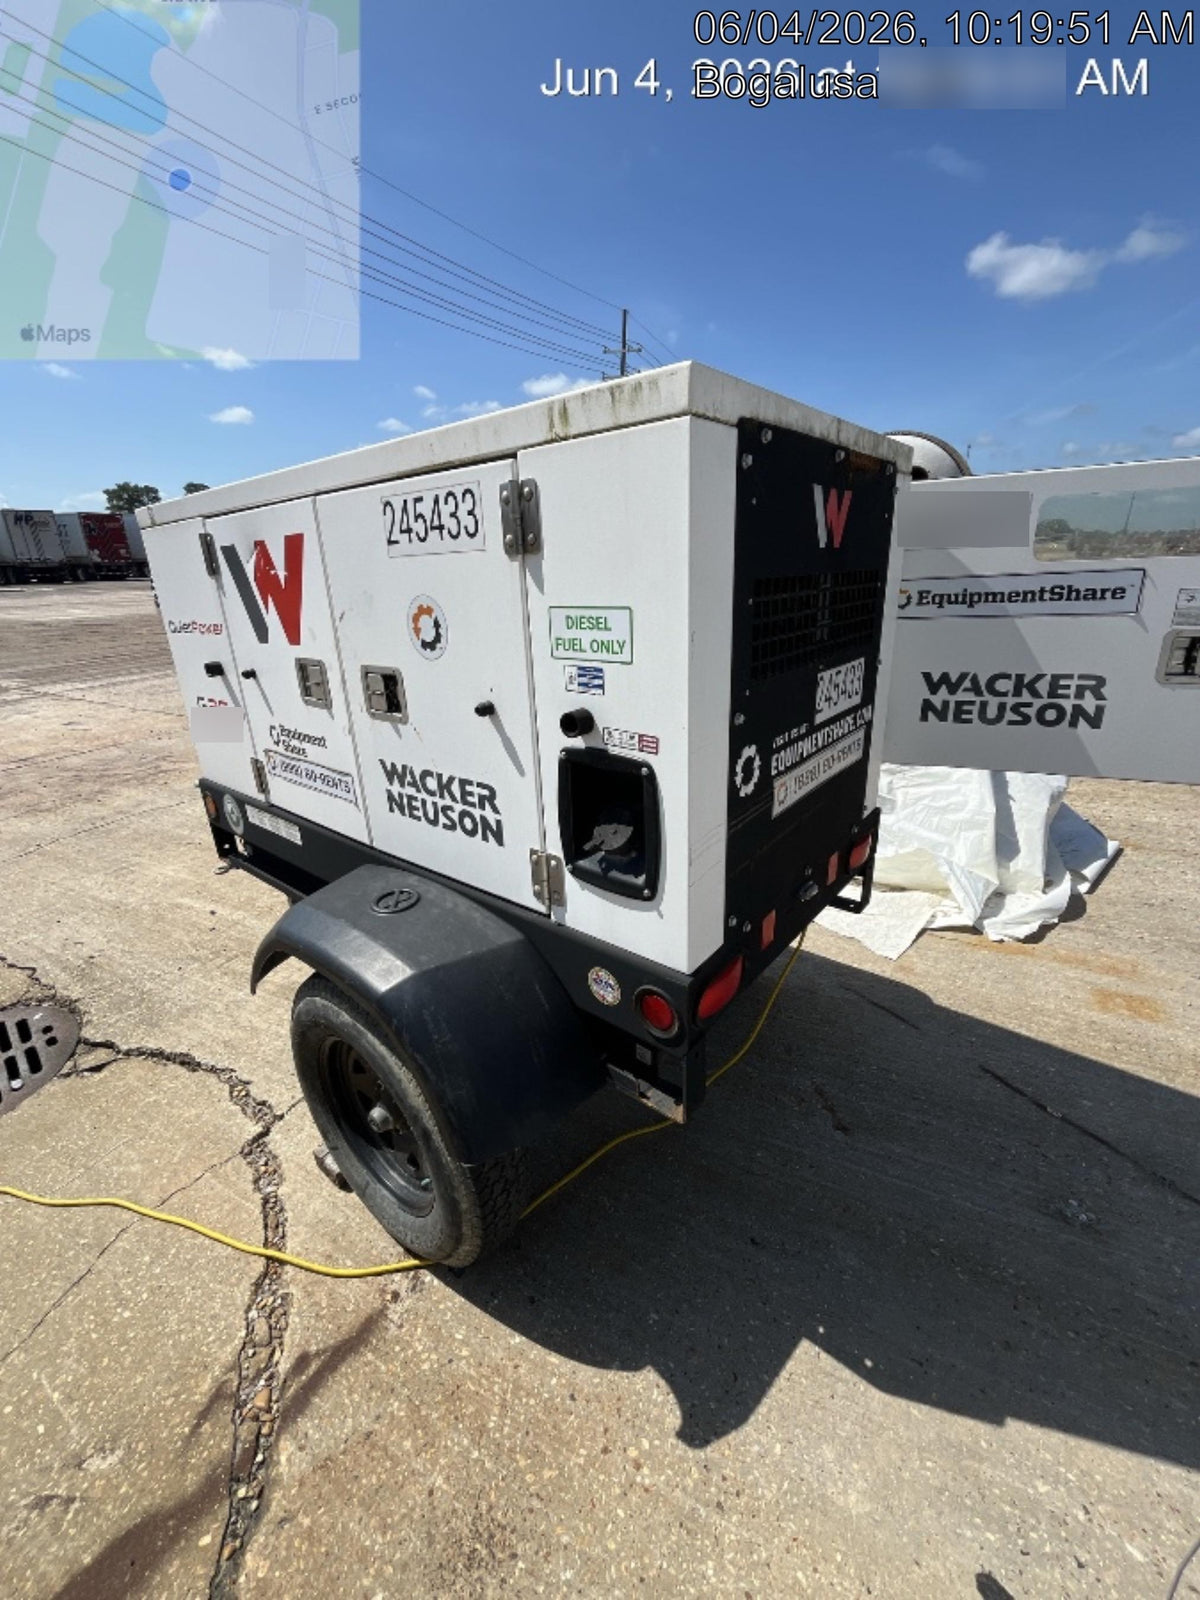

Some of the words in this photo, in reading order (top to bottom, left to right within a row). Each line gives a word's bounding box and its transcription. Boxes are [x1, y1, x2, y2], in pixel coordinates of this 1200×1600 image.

[383, 487, 480, 546] 245433
[915, 584, 1127, 609] EquipmentShare
[565, 615, 612, 632] DIESEL
[555, 637, 587, 652] FUEL
[589, 639, 626, 655] ONLY
[920, 672, 1108, 702] WACKER
[919, 698, 1106, 730] NEUSON
[379, 757, 502, 816] WACKER
[386, 787, 505, 848] NEUSON
